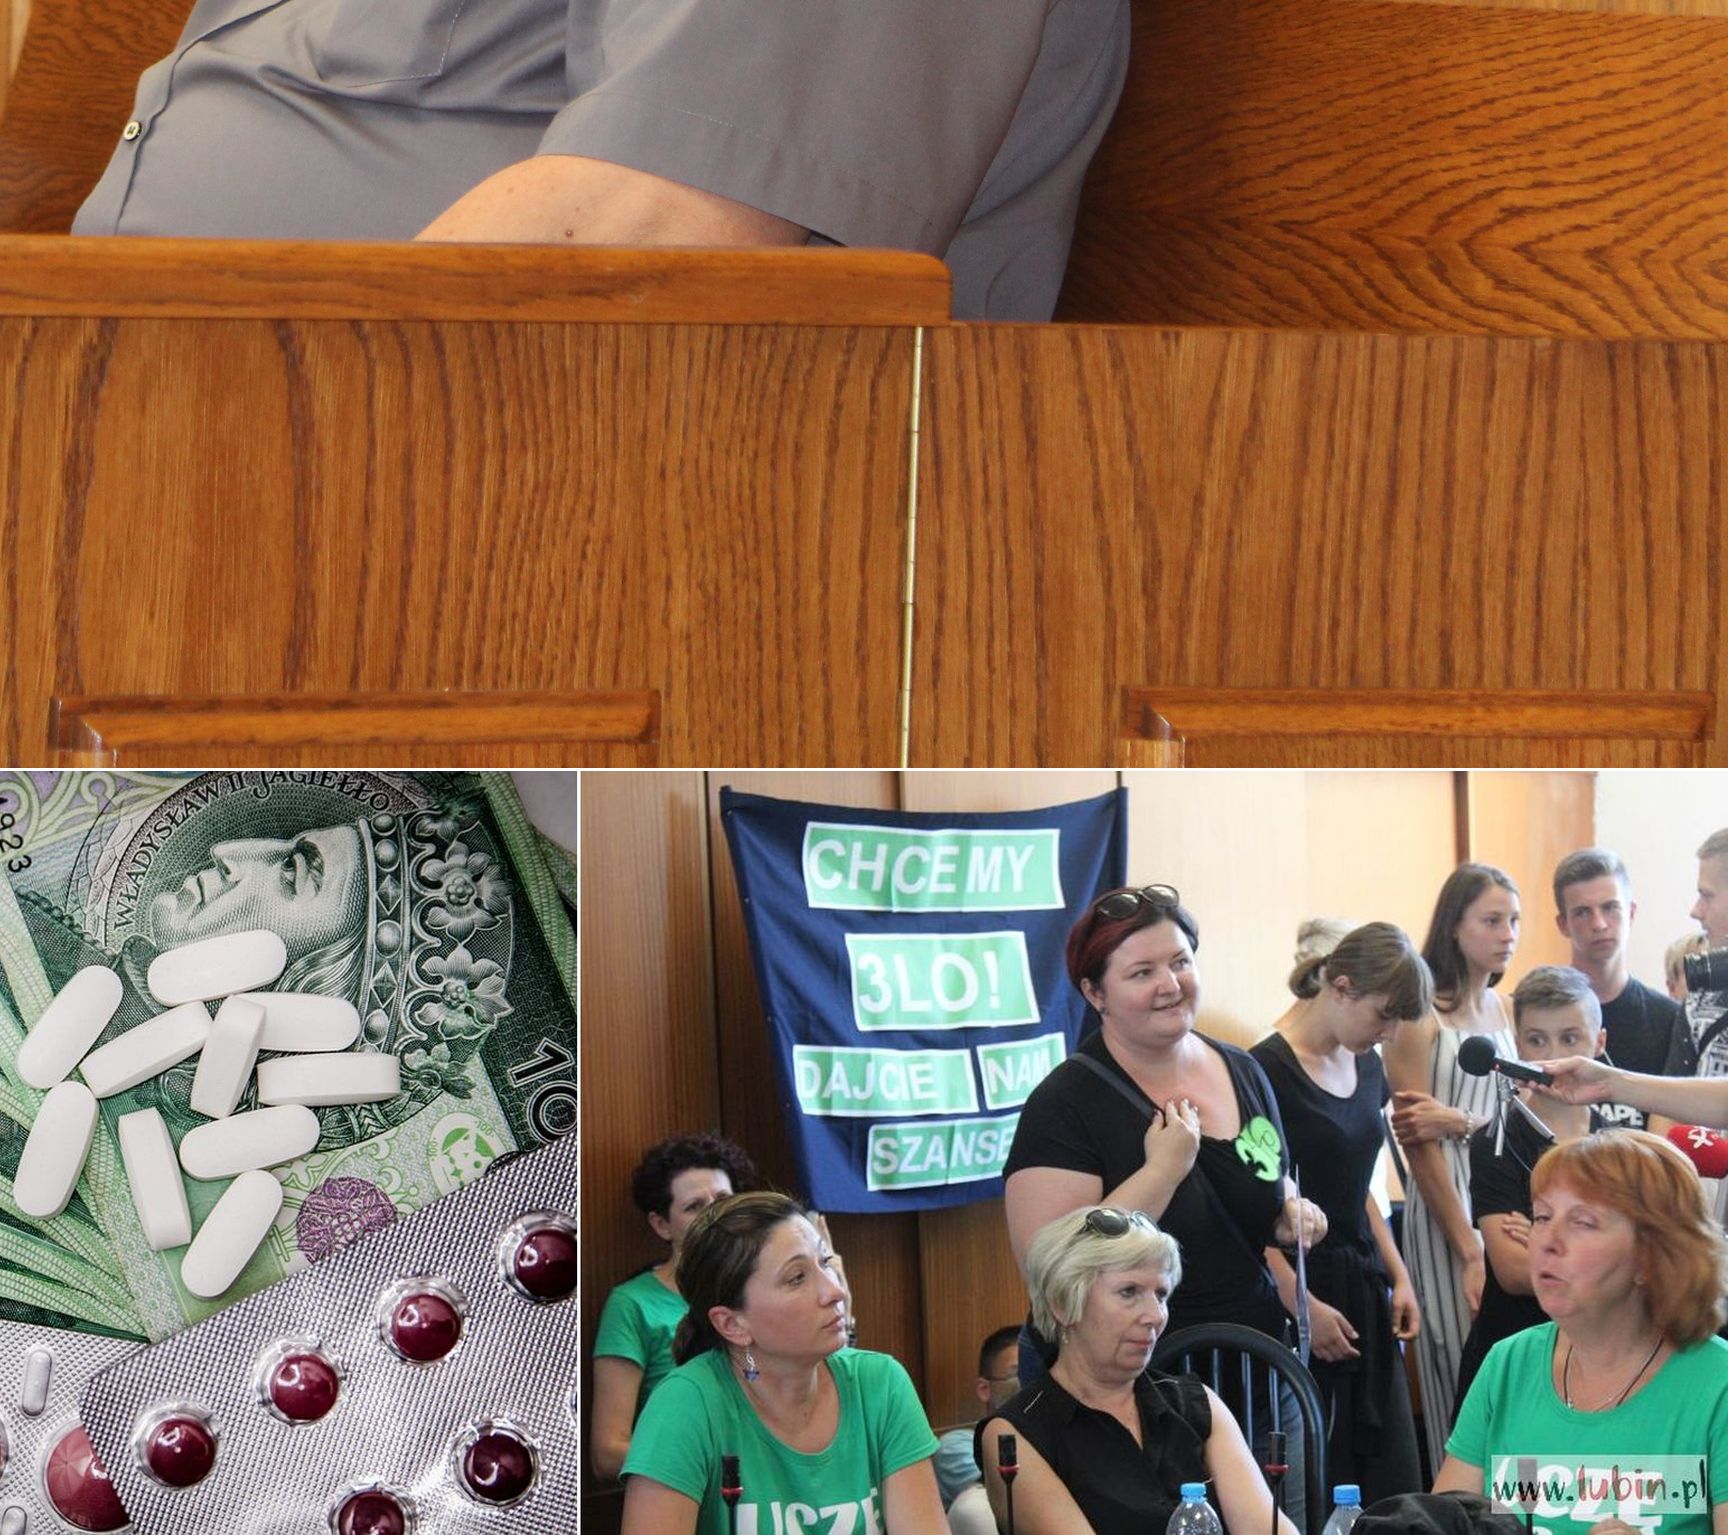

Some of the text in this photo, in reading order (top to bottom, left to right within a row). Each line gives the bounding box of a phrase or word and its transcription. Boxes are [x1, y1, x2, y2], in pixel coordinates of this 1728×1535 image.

[113, 783, 222, 930] WŁADYSŁAW
[857, 951, 1002, 1012] 3LO!
[794, 1059, 940, 1101] DAJCIE
